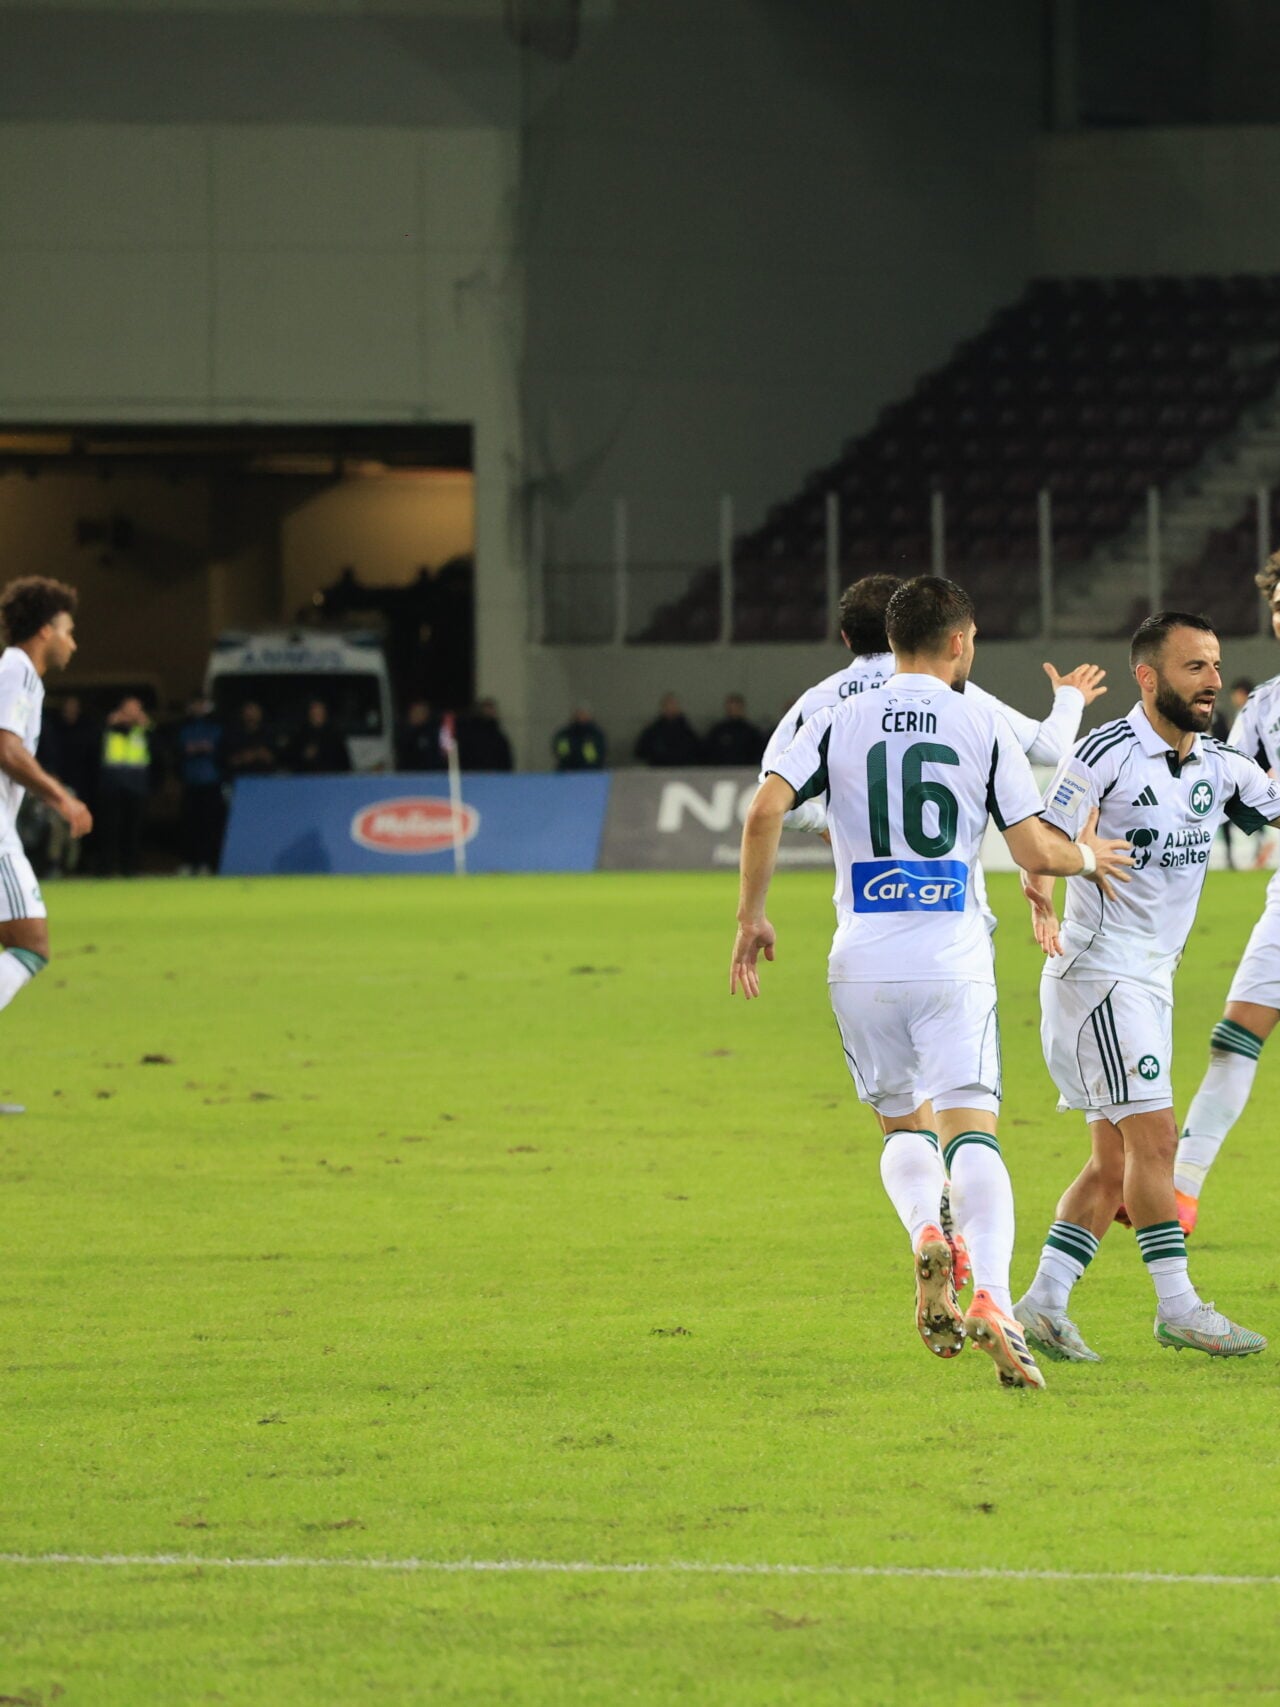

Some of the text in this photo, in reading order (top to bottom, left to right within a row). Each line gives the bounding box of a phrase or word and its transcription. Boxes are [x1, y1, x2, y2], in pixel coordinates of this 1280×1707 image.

[881, 708, 937, 734] ČERIN
[866, 741, 960, 858] 16
[1163, 827, 1211, 849] A Little
[863, 867, 965, 905] Car.gr
